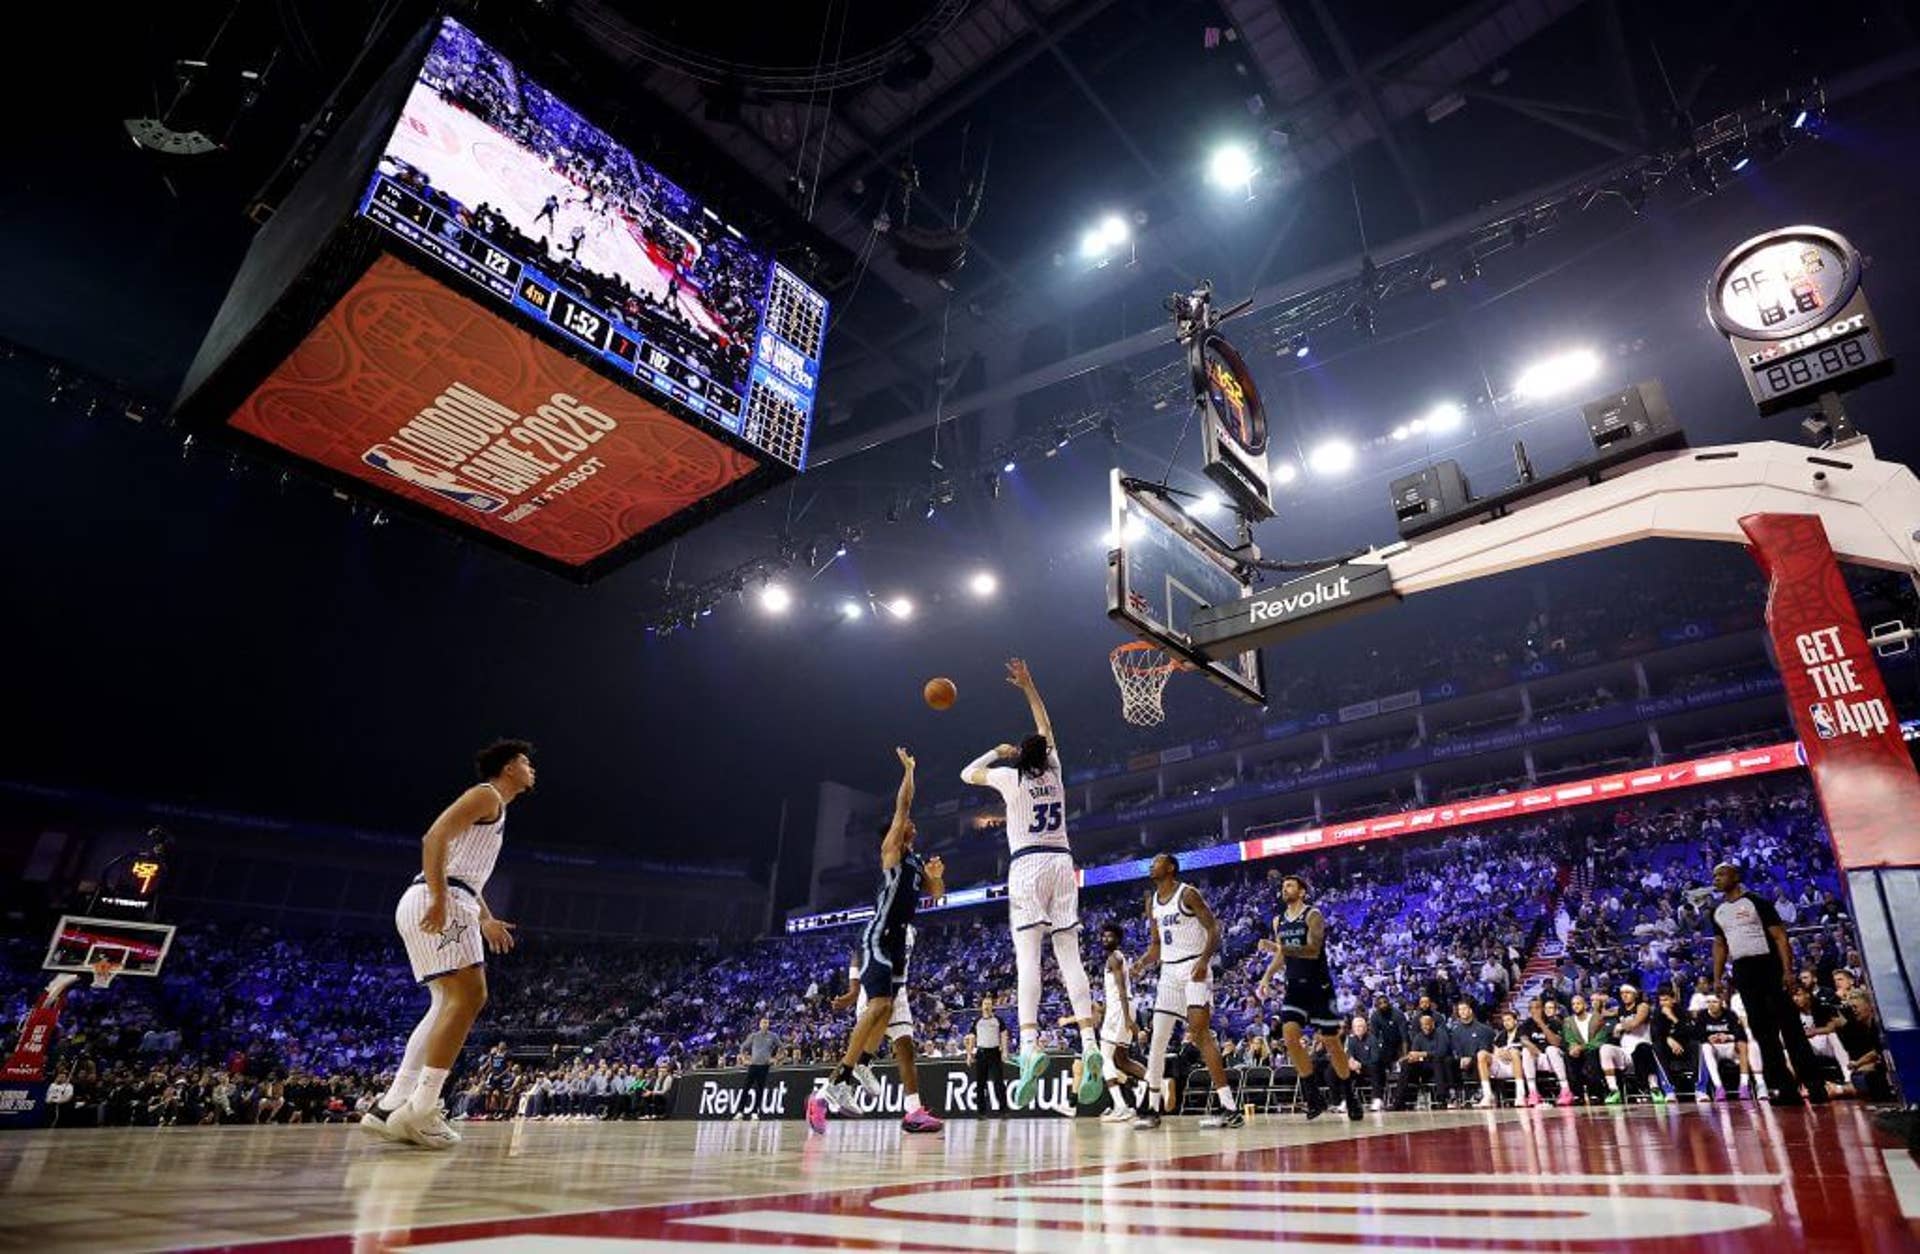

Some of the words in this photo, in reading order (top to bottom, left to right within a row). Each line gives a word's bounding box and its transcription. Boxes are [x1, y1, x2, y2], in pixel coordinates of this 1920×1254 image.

[485, 248, 510, 275] 123
[525, 284, 545, 305] 4TH
[564, 303, 599, 342] 1:52
[1778, 314, 1865, 351] TISSOT
[619, 339, 628, 354] 7
[649, 349, 671, 373] 102
[1767, 339, 1868, 391] 88:88
[389, 381, 521, 468] LONDON
[510, 393, 618, 462] 2026
[460, 437, 562, 495] GAME
[546, 457, 606, 495] TISSOT
[1250, 576, 1351, 624] Revolut
[1796, 626, 1846, 666] GET
[1806, 659, 1864, 698] THE
[1834, 698, 1890, 738] App
[1029, 802, 1062, 832] 35
